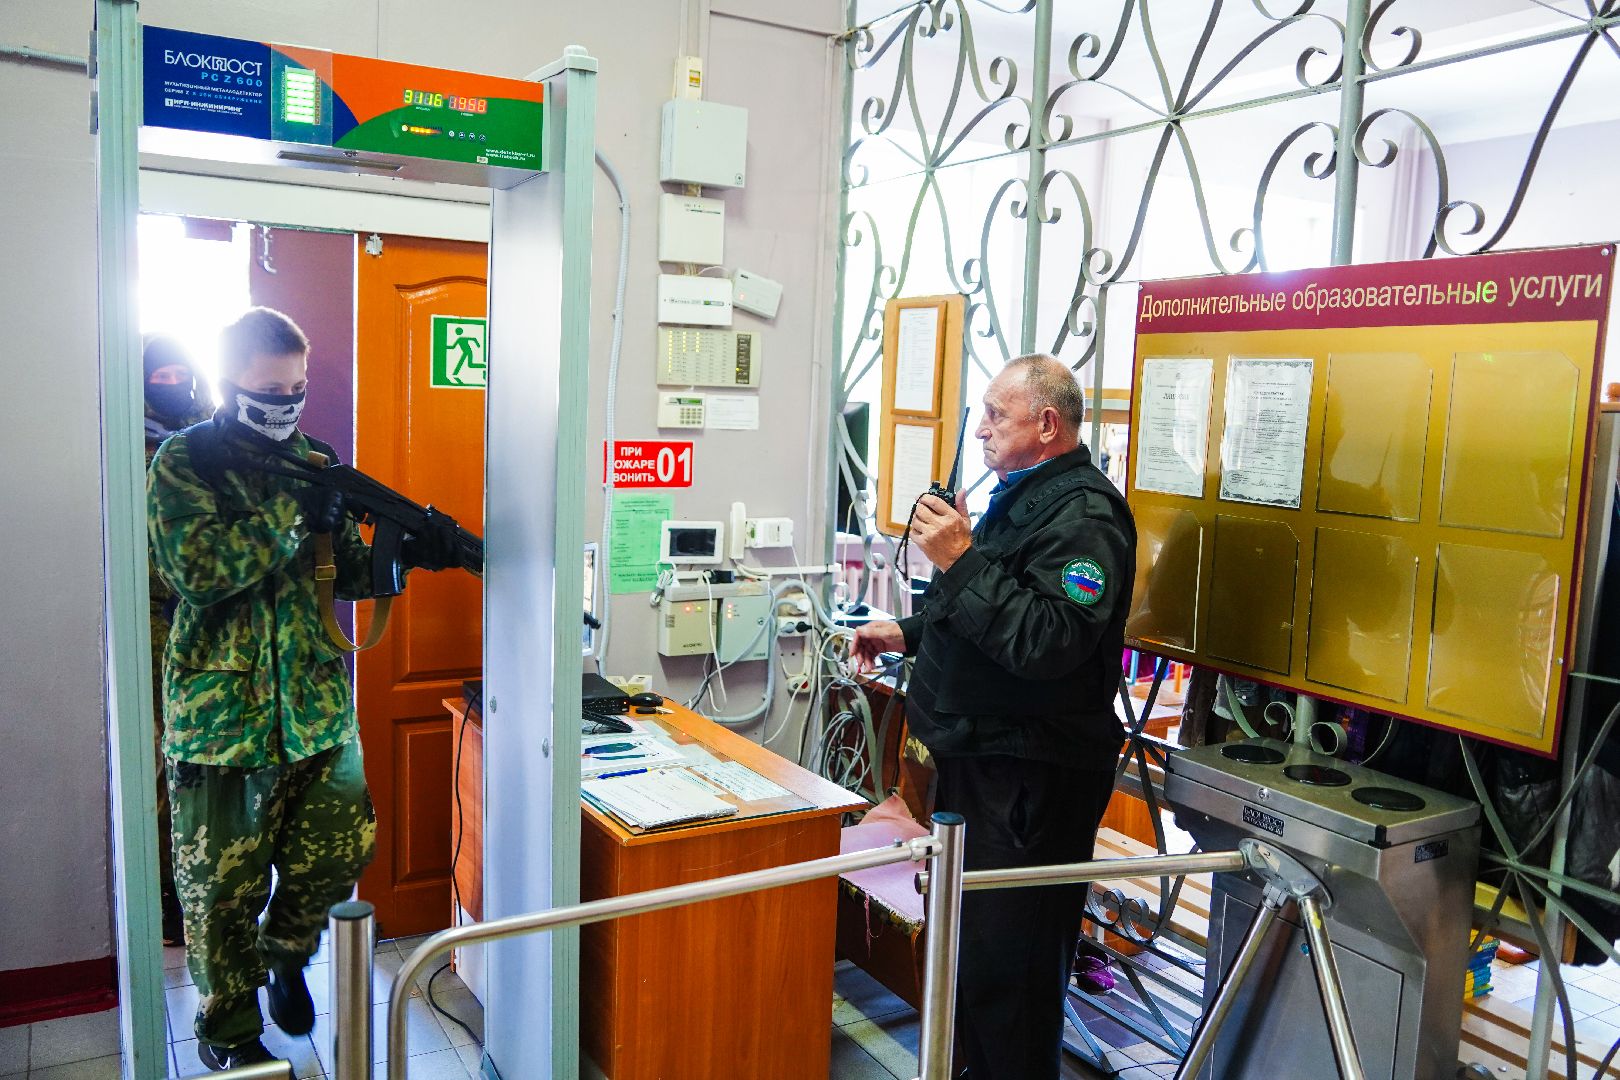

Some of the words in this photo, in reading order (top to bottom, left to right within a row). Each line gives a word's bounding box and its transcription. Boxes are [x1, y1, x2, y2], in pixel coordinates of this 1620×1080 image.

[164, 49, 263, 76] БЛОКПОСТ
[223, 74, 231, 83] Z
[236, 76, 263, 88] 600
[1140, 291, 1287, 323] Дополнительные
[1292, 280, 1498, 315] образовательные
[1507, 273, 1603, 307] услуги
[620, 446, 642, 457] ПРИ
[613, 459, 656, 470] ОЖАРЕ
[656, 446, 691, 483] 01
[613, 472, 656, 483] ВОНИТЬ
